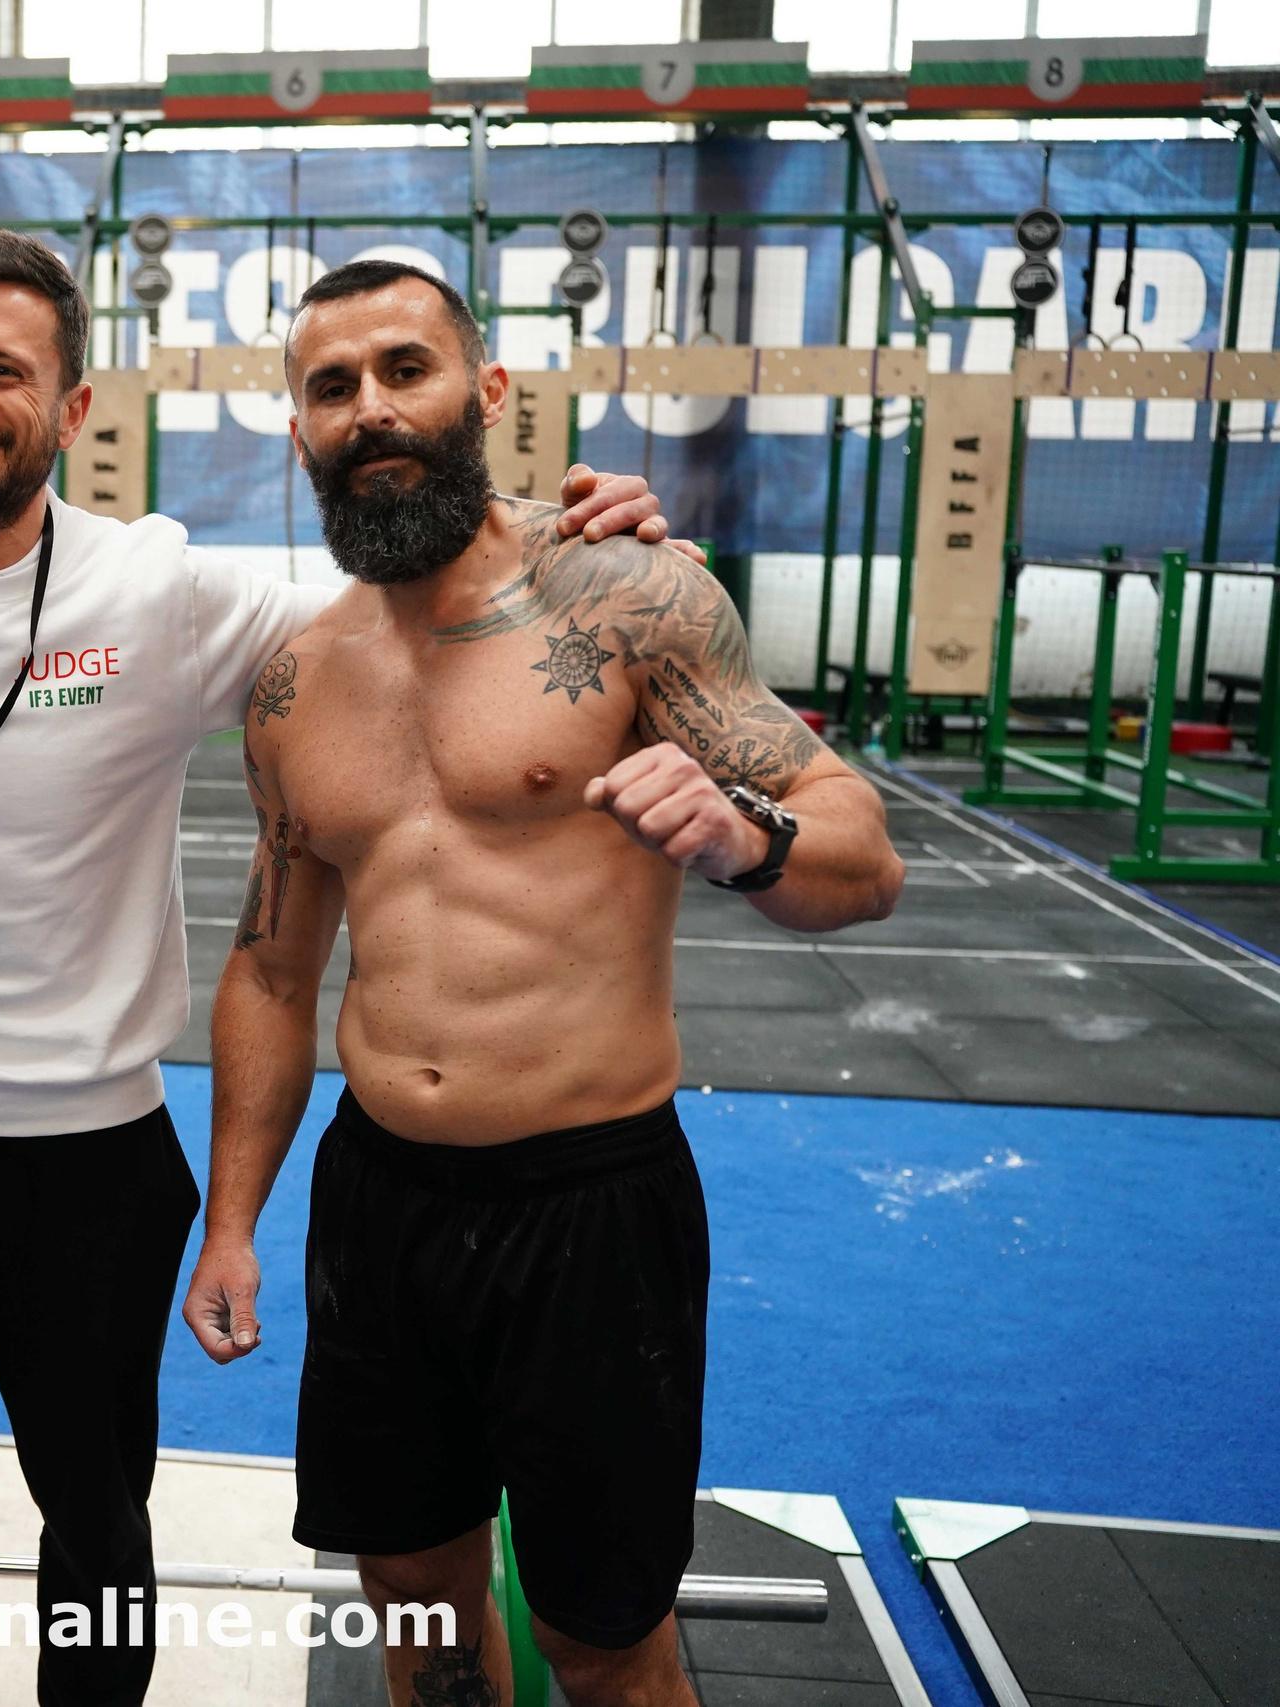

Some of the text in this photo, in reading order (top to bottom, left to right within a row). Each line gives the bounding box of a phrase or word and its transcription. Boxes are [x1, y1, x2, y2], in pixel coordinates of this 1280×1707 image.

[286, 68, 306, 98] 6
[659, 60, 679, 90] 7
[1043, 57, 1064, 88] 8
[494, 243, 1280, 443] BULGARI
[93, 429, 118, 503] FFA
[944, 435, 981, 549] BFFA
[28, 685, 104, 708] IF3 EVENT
